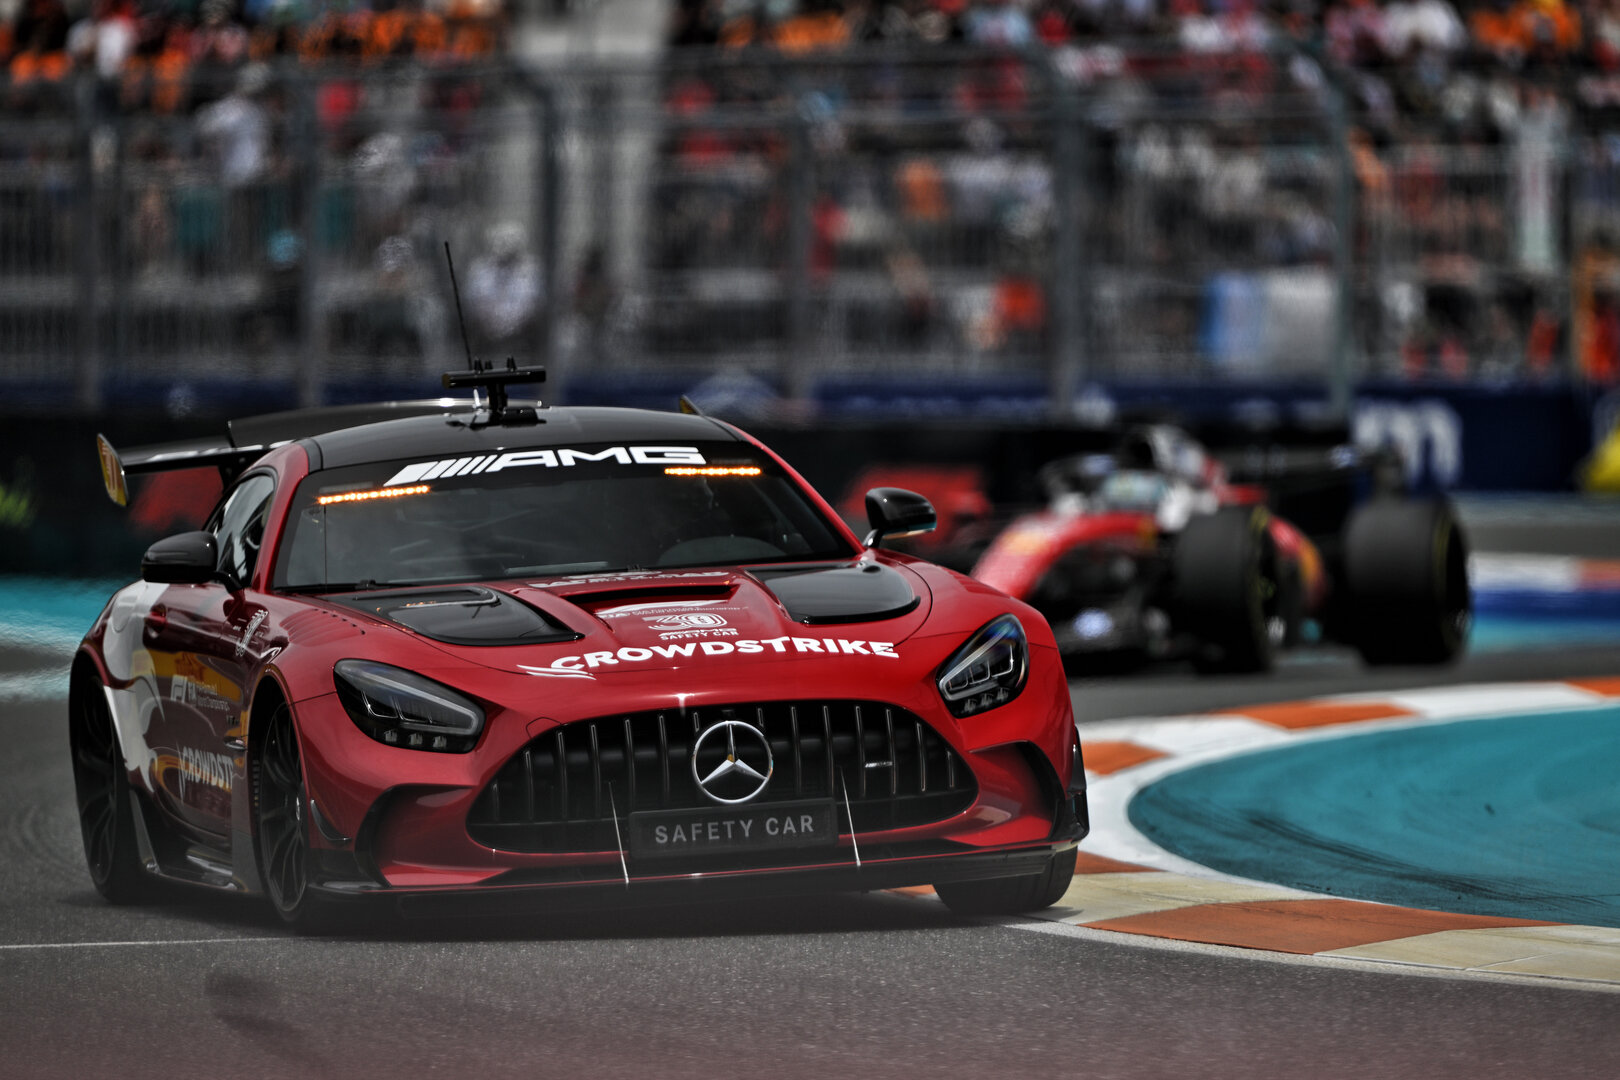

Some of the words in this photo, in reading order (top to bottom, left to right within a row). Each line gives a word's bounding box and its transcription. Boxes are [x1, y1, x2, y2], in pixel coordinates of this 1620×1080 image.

[484, 446, 706, 473] AMG
[660, 631, 708, 641] SAFETY
[550, 635, 900, 671] CROWDSTRIKE
[655, 818, 753, 845] SAFETY
[765, 815, 814, 837] CAR
